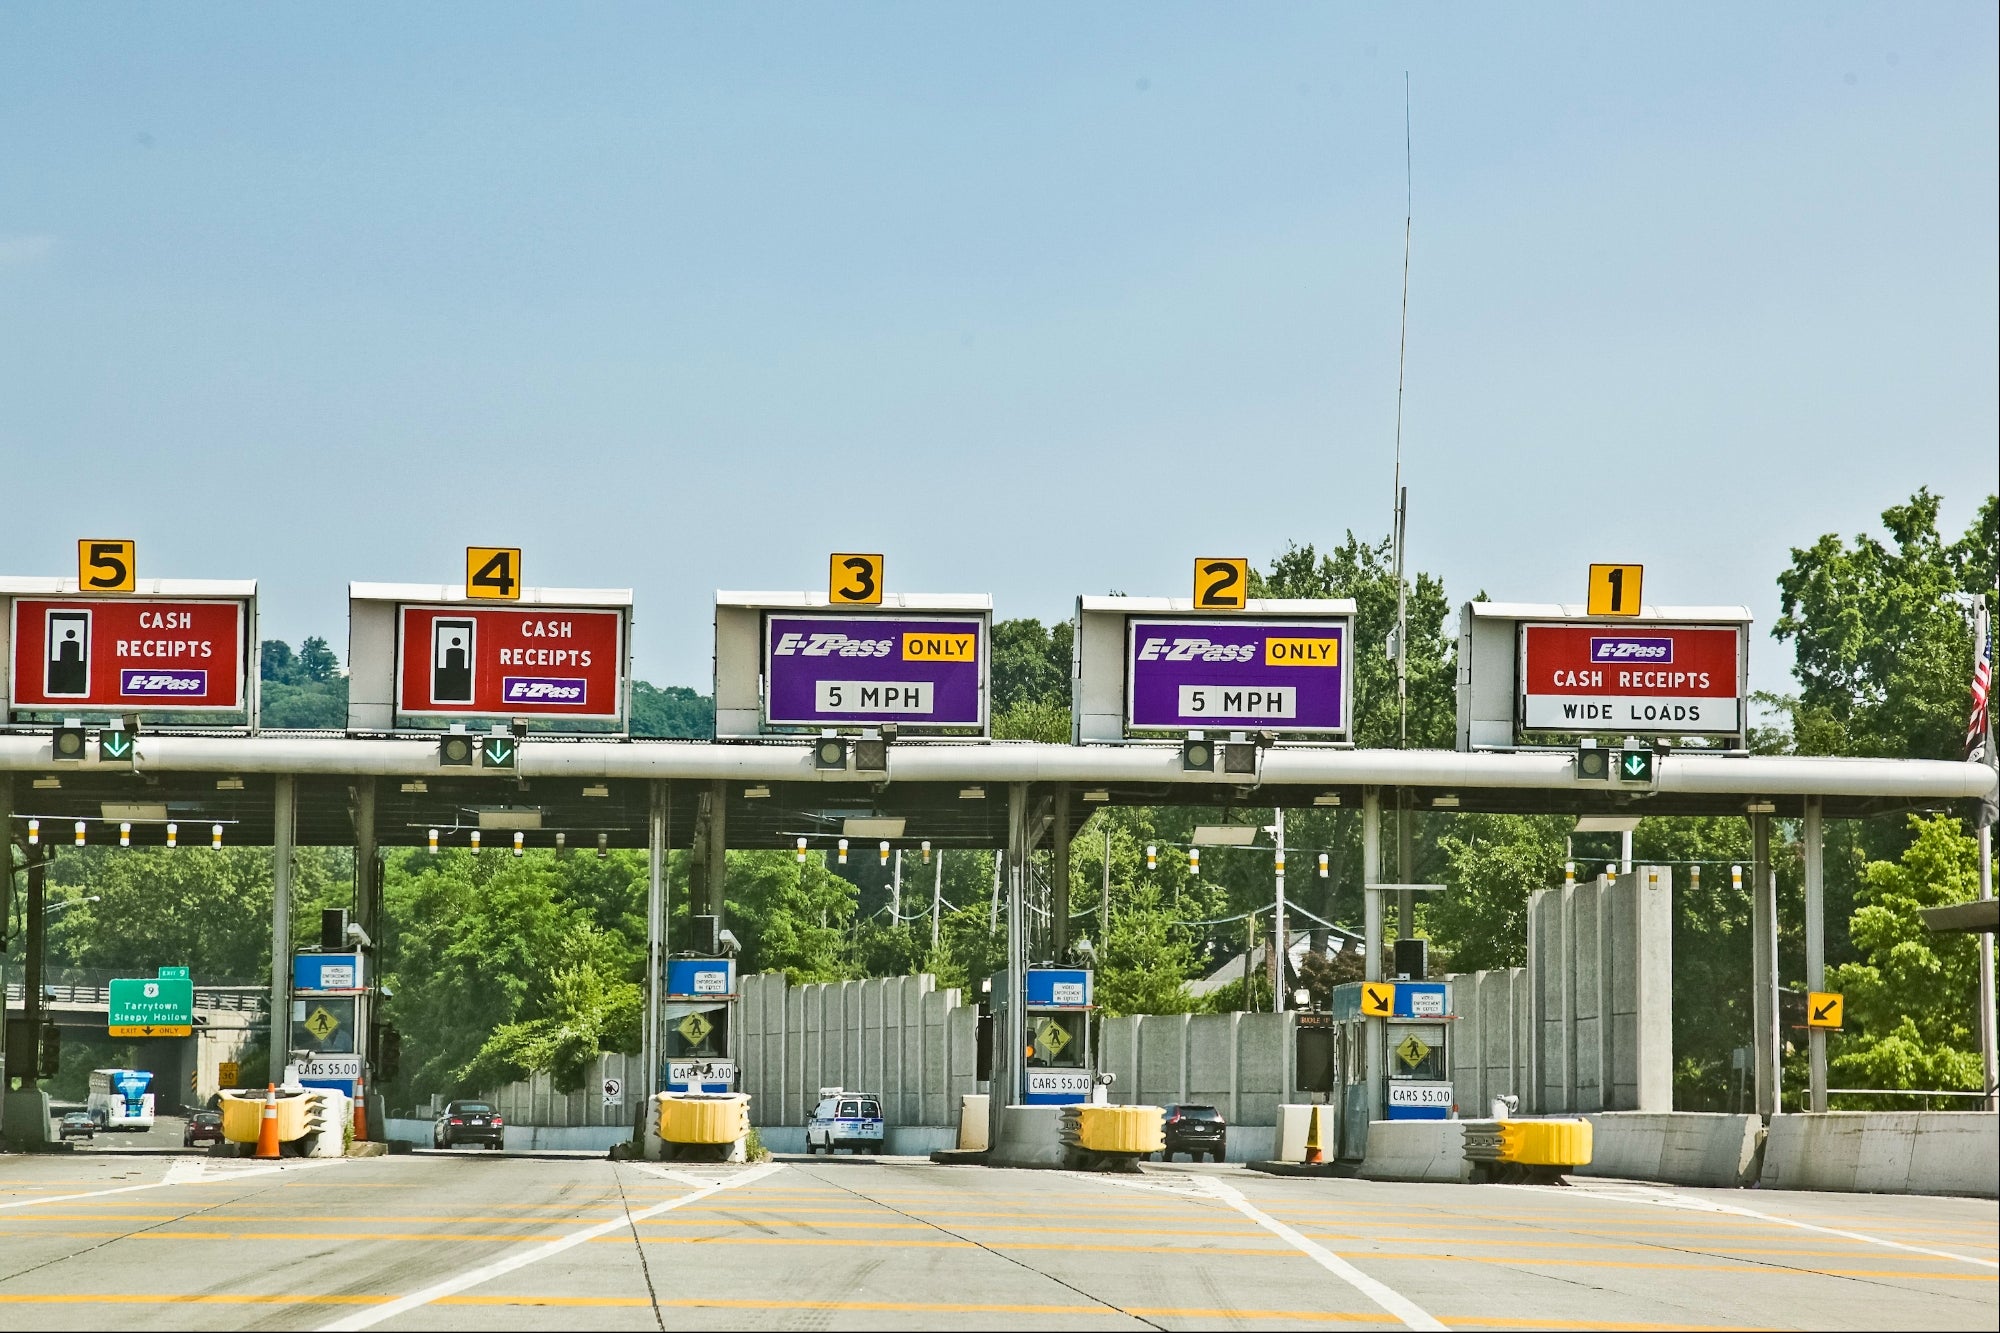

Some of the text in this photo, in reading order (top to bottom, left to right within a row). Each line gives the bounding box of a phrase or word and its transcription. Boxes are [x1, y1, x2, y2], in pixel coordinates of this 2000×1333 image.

[89, 544, 126, 588] 5
[472, 552, 514, 595] 4
[838, 557, 875, 600] 3
[1202, 562, 1239, 605] 2
[1608, 569, 1623, 611] 1
[139, 612, 191, 629] CASH
[521, 620, 572, 638] CASH
[116, 640, 212, 657] RECEIPTS
[774, 633, 968, 657] E-ZPass ONLY
[1138, 638, 1331, 662] E-ZPass ONLY
[1597, 643, 1666, 657] E-ZPass
[500, 648, 592, 667] RECEIPTS
[127, 675, 200, 690] E-ZPass
[1553, 670, 1710, 688] CASH RECEIPTS
[509, 683, 580, 698] E-ZPass
[829, 687, 919, 707] 5 MPH
[1192, 691, 1282, 712] 5 MPH
[1563, 704, 1700, 721] WIDE LOADS
[180, 969, 186, 977] 9
[148, 987, 154, 995] 9
[124, 1002, 178, 1011] Tarrytown
[114, 1013, 188, 1022] Sleepy Hollow
[222, 1072, 233, 1080] 30
[298, 1063, 357, 1075] CARS $5.00
[673, 1067, 692, 1079] CAR
[1032, 1077, 1089, 1089] CARS $5.00
[1393, 1090, 1450, 1102] CARS $5.00
